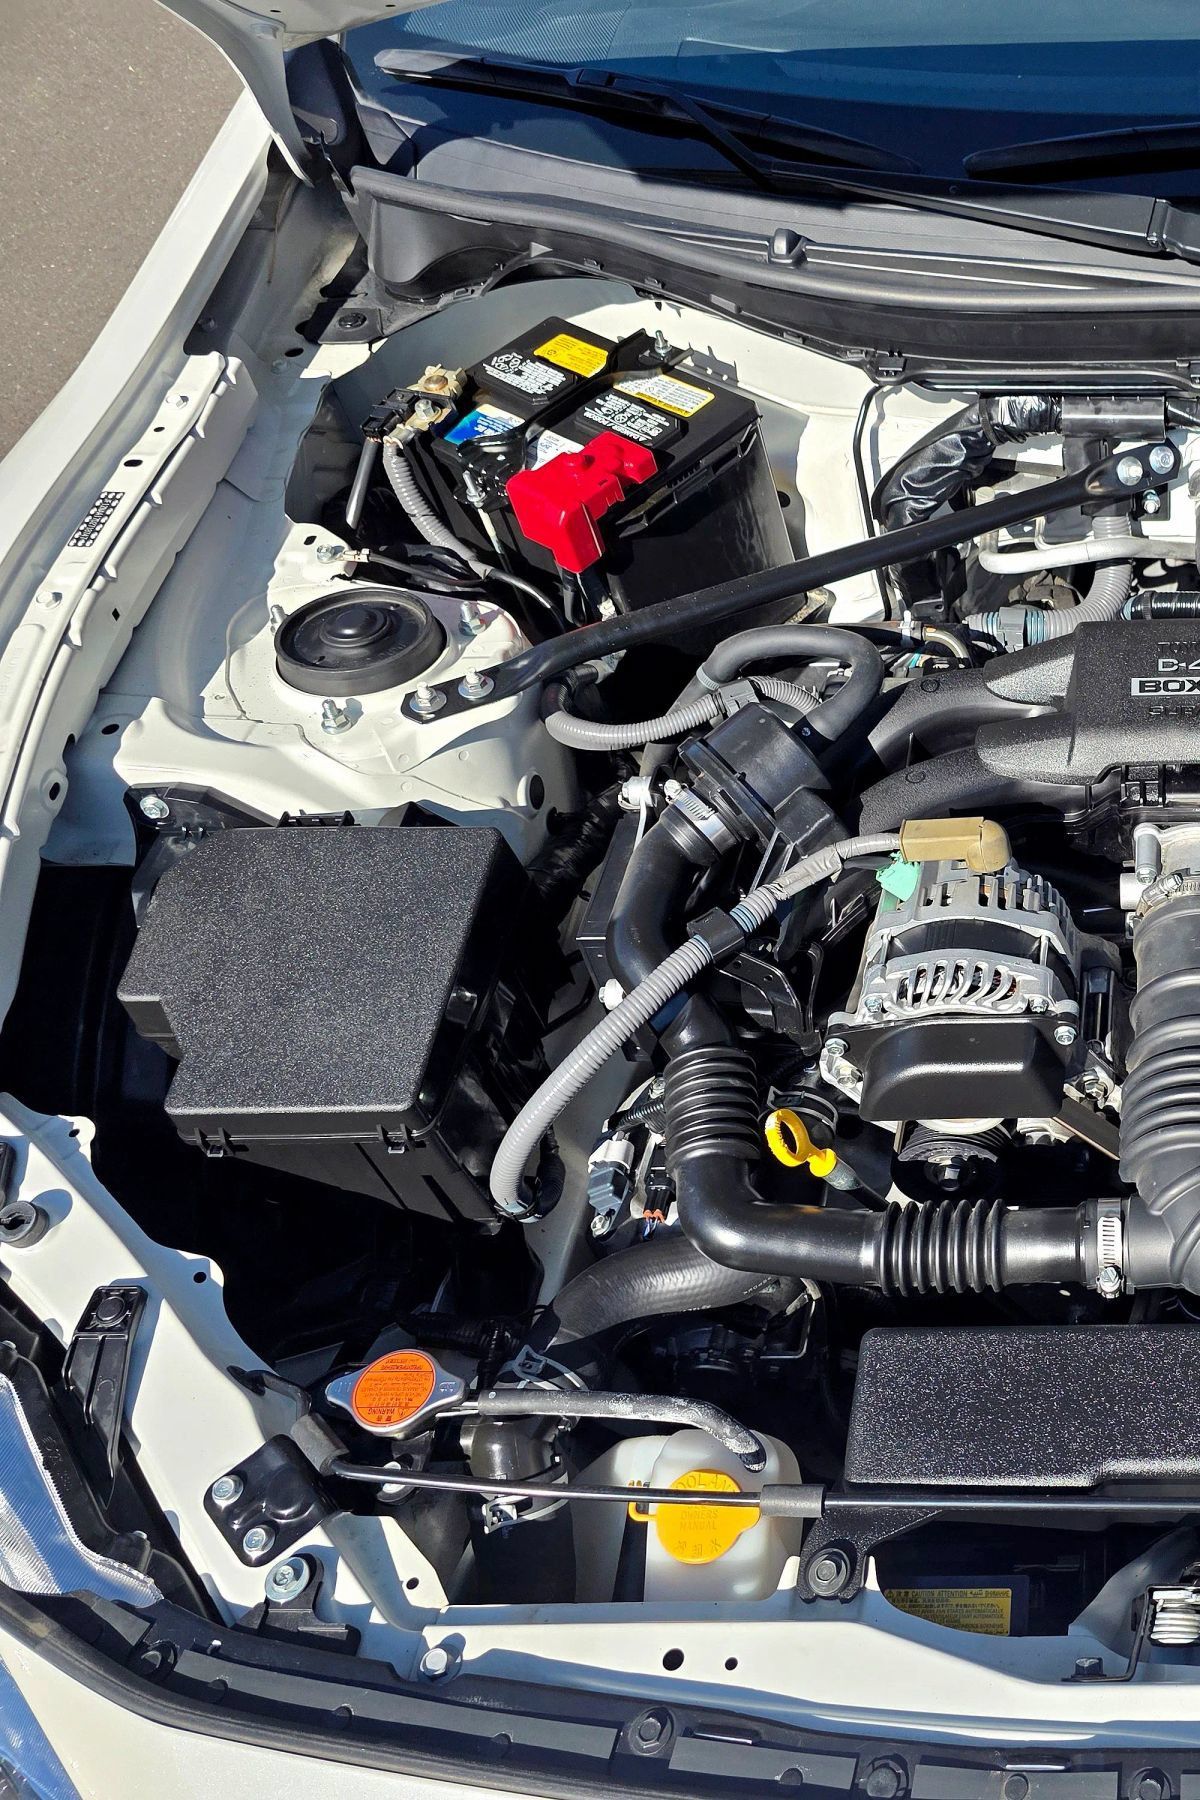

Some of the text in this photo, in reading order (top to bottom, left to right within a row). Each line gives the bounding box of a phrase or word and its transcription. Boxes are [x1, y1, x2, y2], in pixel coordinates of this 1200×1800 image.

[367, 1406, 396, 1415] WARNING
[679, 1519, 717, 1530] MANUAL
[911, 1590, 935, 1598] CAUTION
[937, 1590, 968, 1598] ATTENTION
